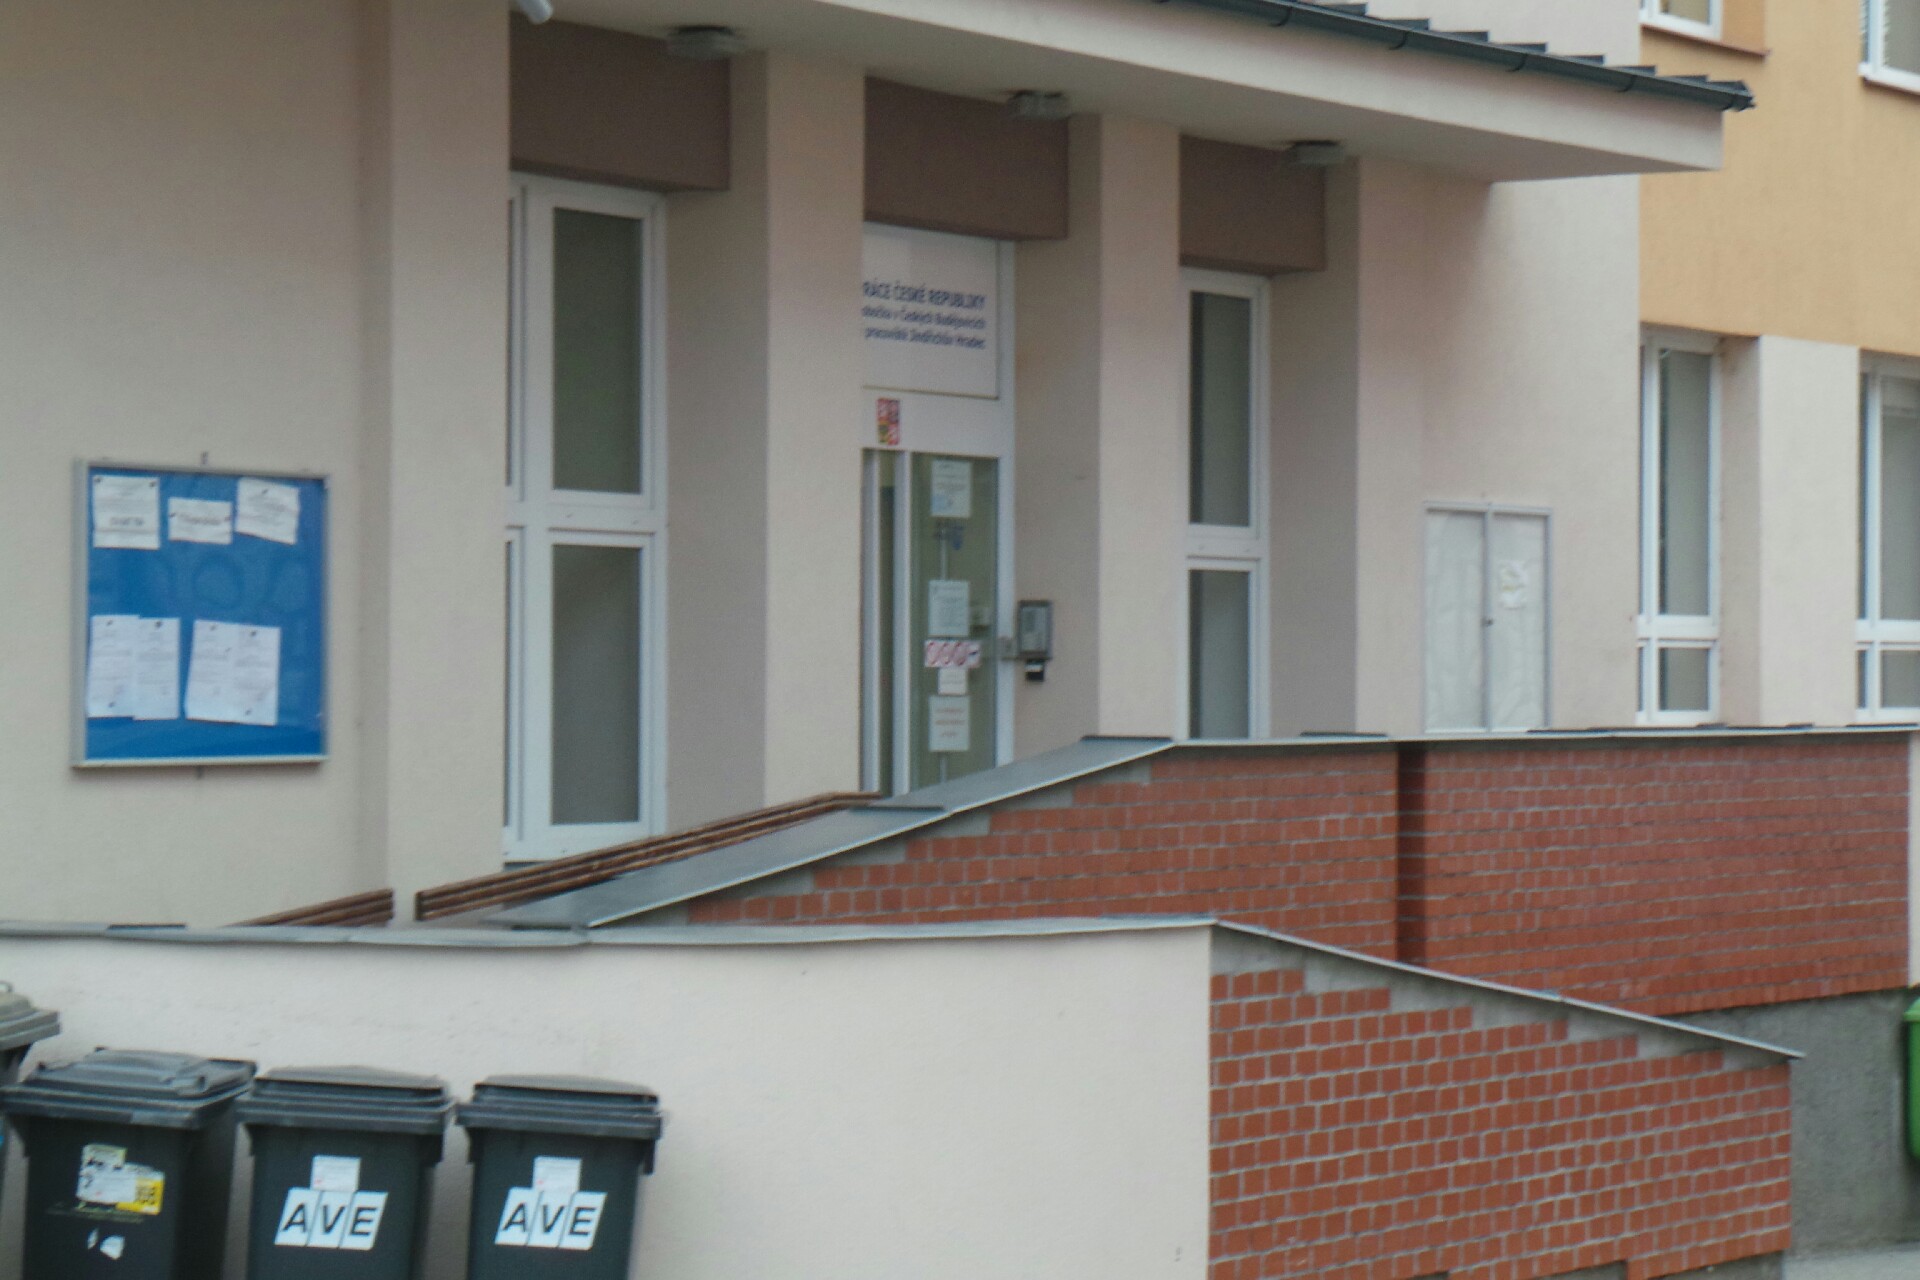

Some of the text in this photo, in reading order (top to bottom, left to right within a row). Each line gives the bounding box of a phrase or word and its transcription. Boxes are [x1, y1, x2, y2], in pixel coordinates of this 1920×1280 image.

[894, 280, 926, 302] ČESKÉ
[928, 288, 985, 309] REPUBLIKY
[281, 1202, 377, 1236] AVE
[501, 1202, 597, 1236] AVE
